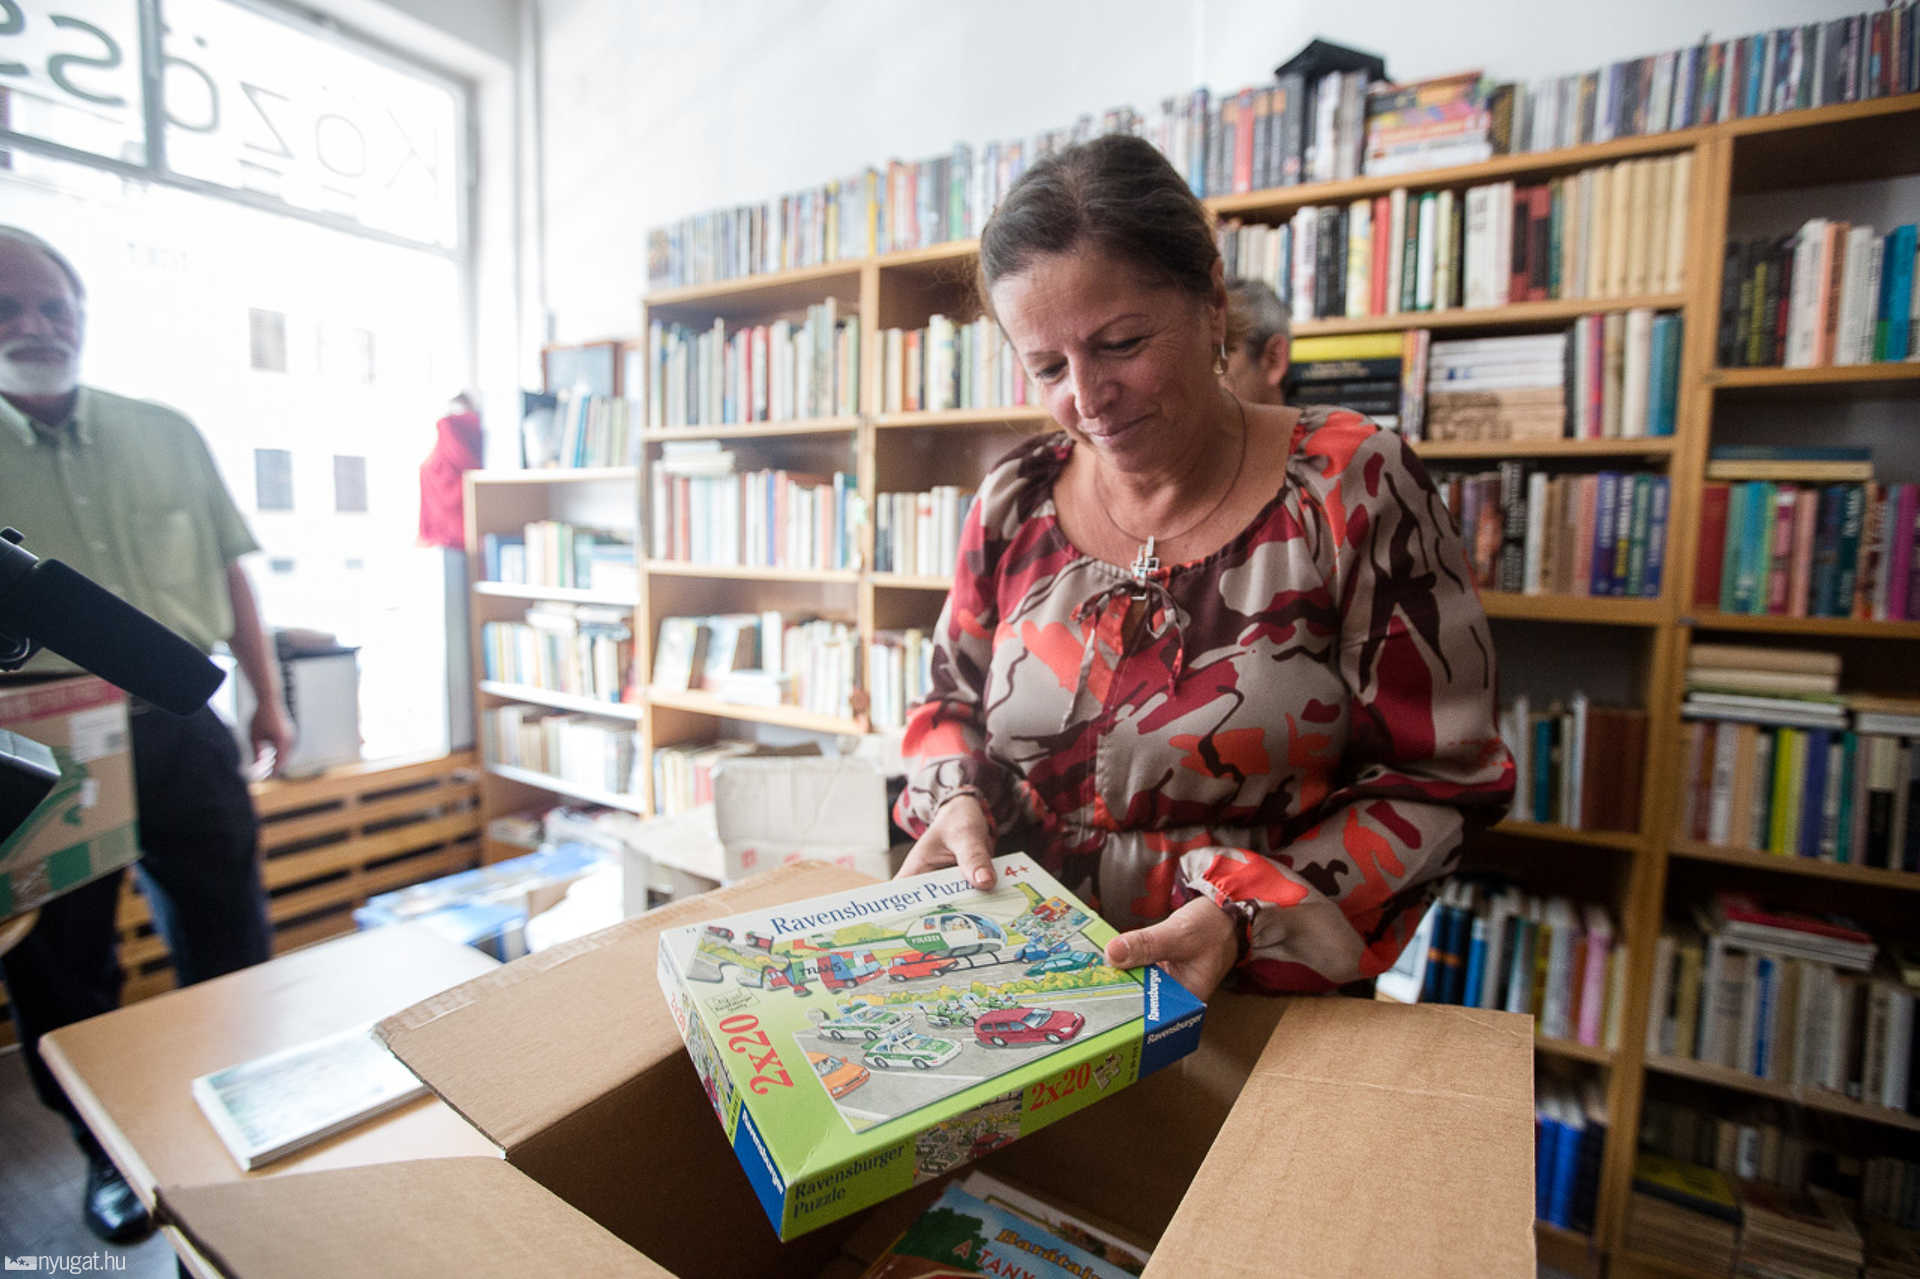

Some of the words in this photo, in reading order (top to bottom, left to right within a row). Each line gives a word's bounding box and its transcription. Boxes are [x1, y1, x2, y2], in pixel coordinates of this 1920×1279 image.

[1004, 864, 1029, 877] 4+
[770, 889, 922, 935] Ravensburger
[923, 879, 975, 899] Puzz
[719, 1014, 794, 1095] 2x20
[1029, 1063, 1091, 1112] 2x20
[794, 1144, 905, 1200] Ravensburger
[793, 1186, 846, 1219] Puzzle
[952, 1239, 973, 1260] A
